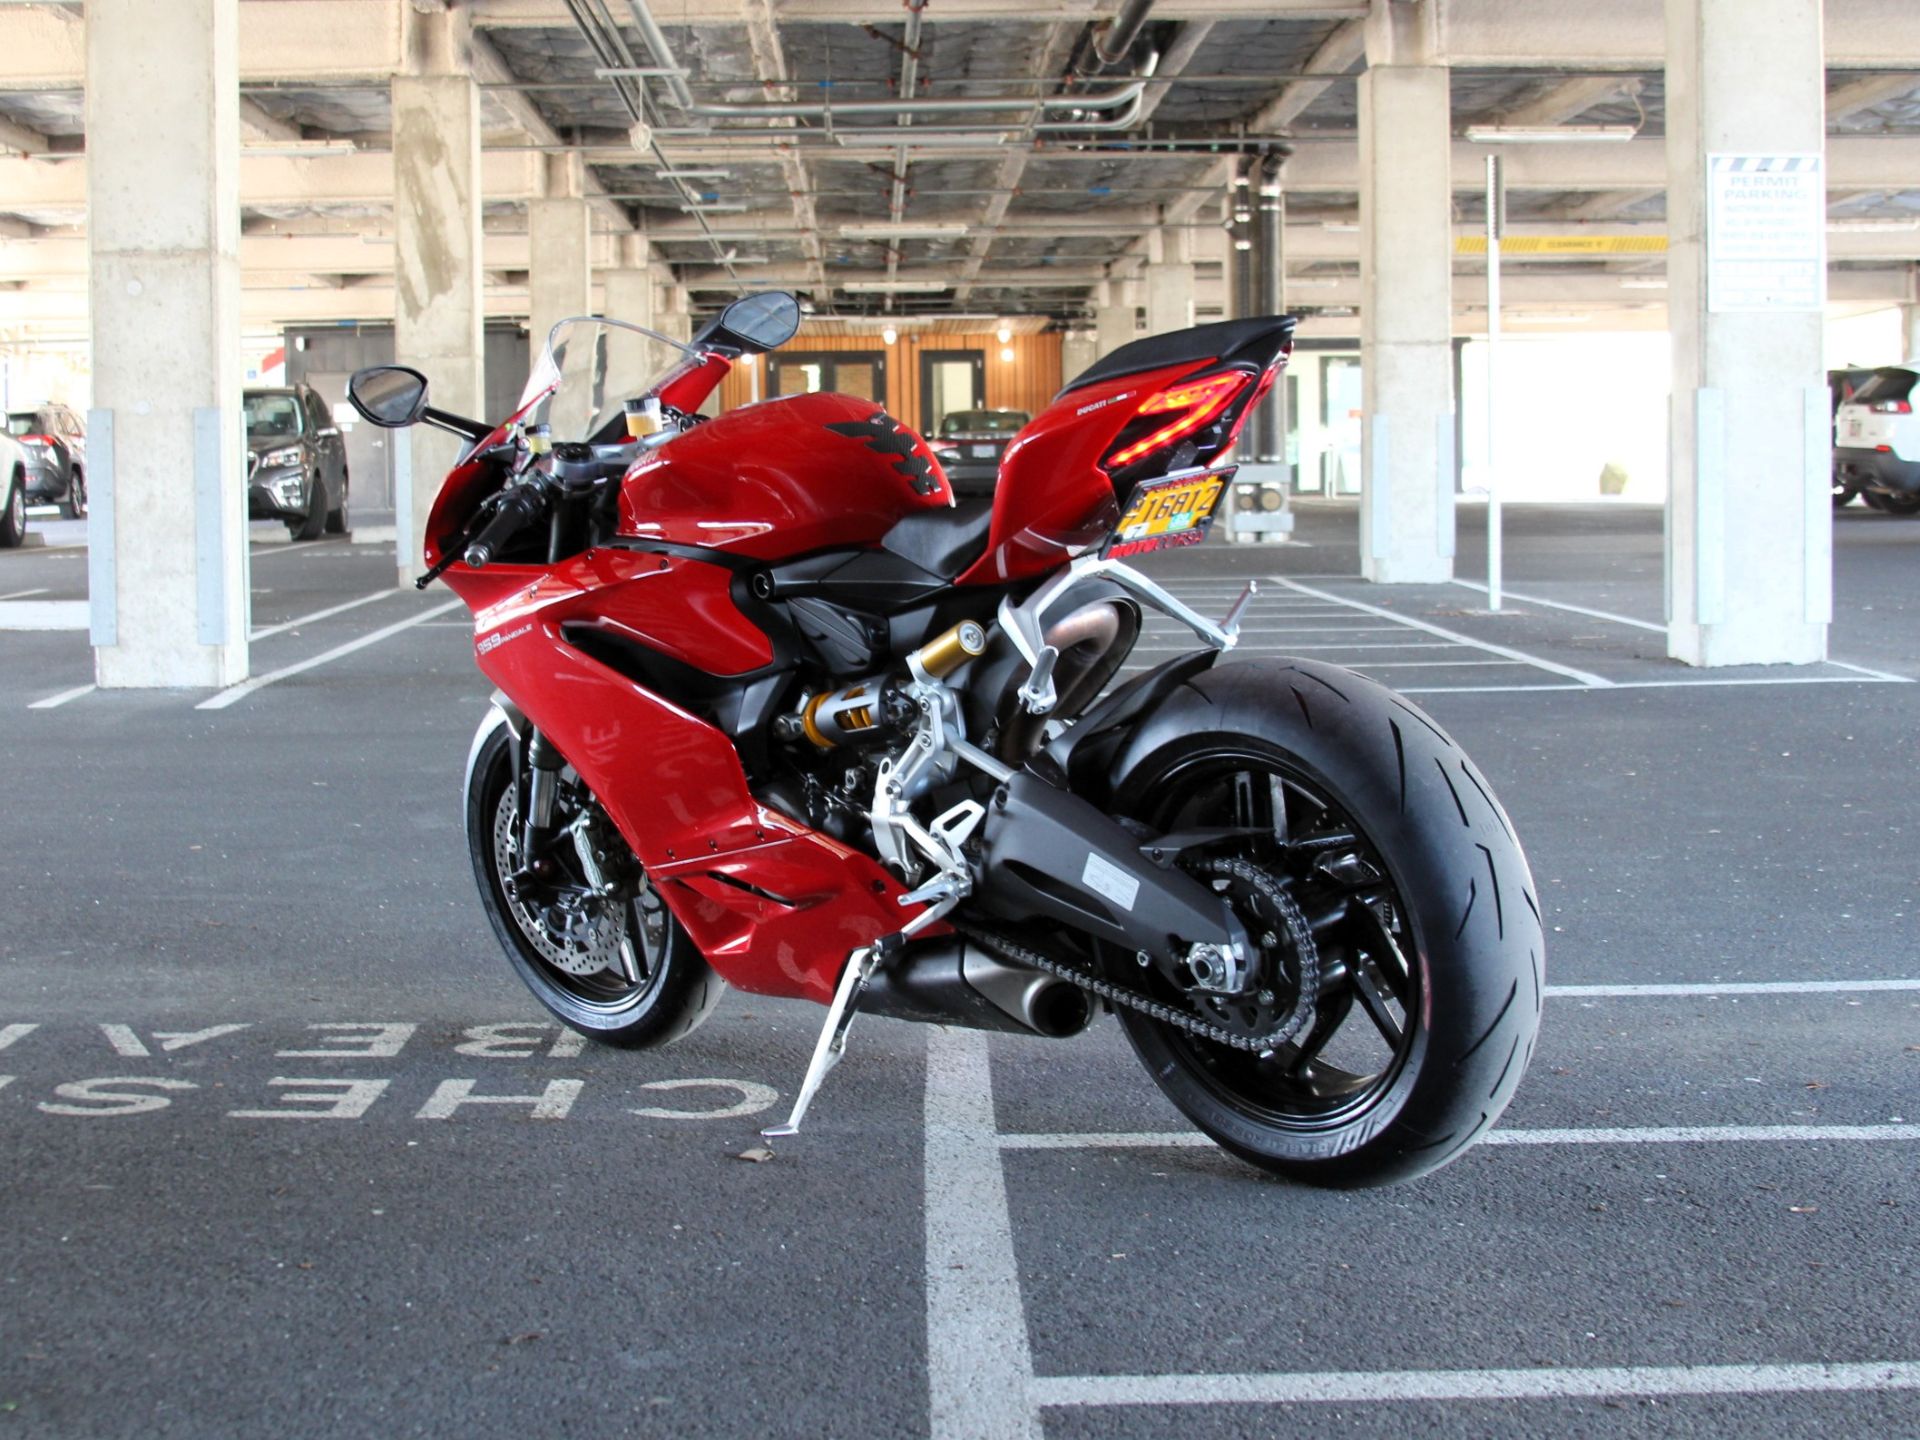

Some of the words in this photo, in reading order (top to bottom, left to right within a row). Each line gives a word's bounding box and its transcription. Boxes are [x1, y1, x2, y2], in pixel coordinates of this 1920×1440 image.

[1730, 176, 1799, 186] PERMIT
[1724, 190, 1809, 200] PARKING
[1076, 399, 1107, 416] DUCATI
[0, 1075, 779, 1119] CHES
